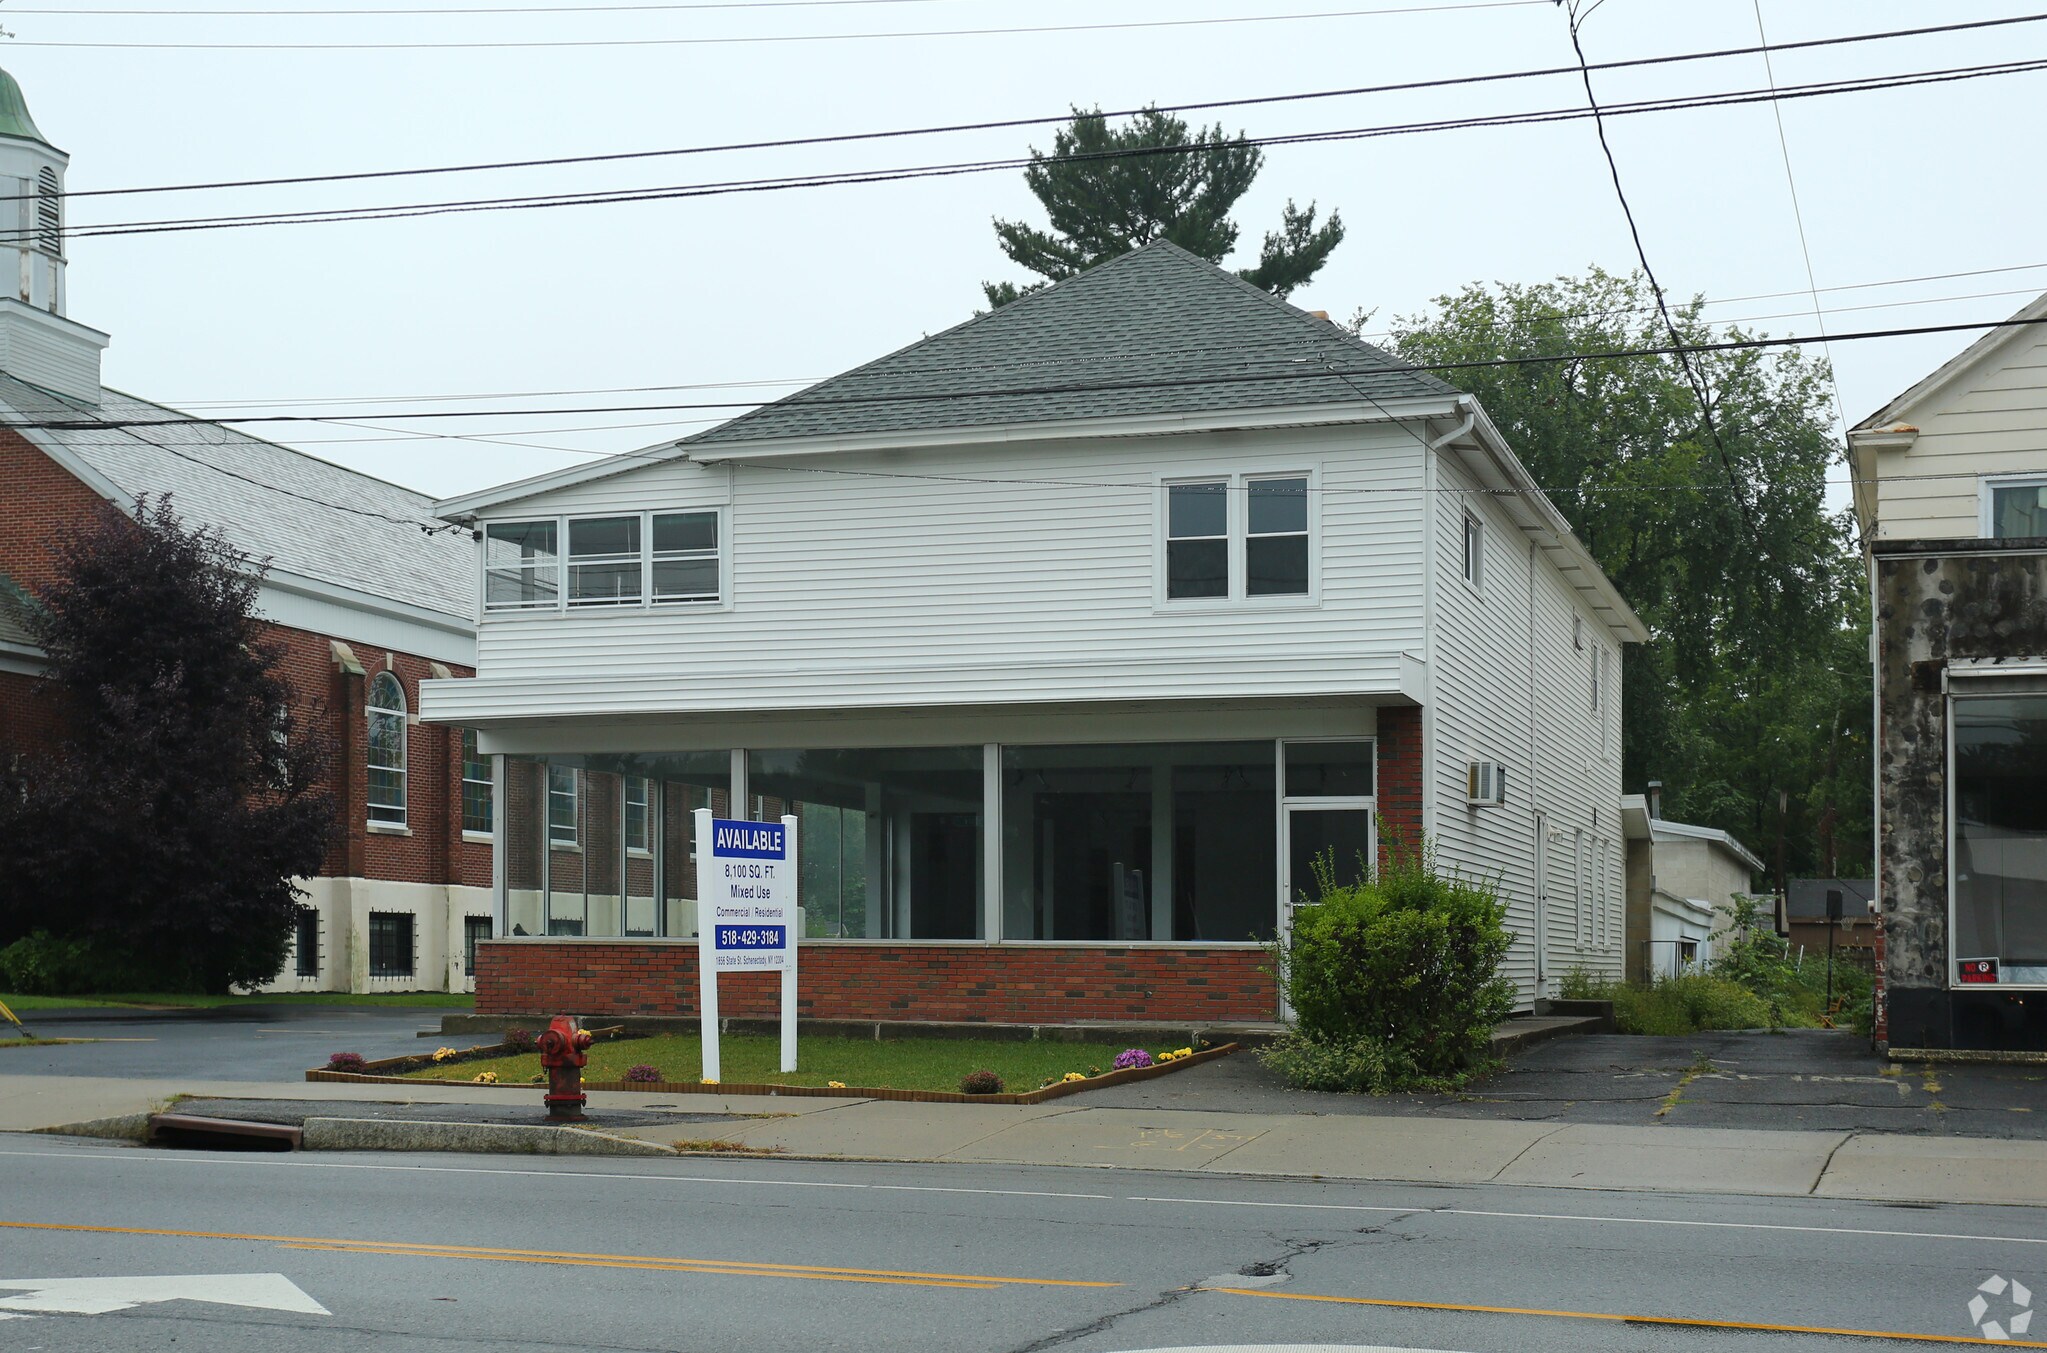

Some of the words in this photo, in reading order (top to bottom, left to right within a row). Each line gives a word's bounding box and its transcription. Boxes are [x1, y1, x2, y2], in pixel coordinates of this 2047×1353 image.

[717, 827, 782, 852] AVAILABLE
[725, 864, 747, 880] 8,100
[749, 864, 763, 879] SQ.
[765, 865, 775, 879] FT.
[730, 884, 754, 899] Mixed
[756, 885, 771, 899] Use
[716, 906, 750, 917] Commercial
[755, 907, 783, 917] Residential
[722, 930, 779, 945] 518-429-3184
[726, 955, 736, 965] State
[1964, 963, 1976, 973] NO
[1961, 973, 1996, 983] PARKING
